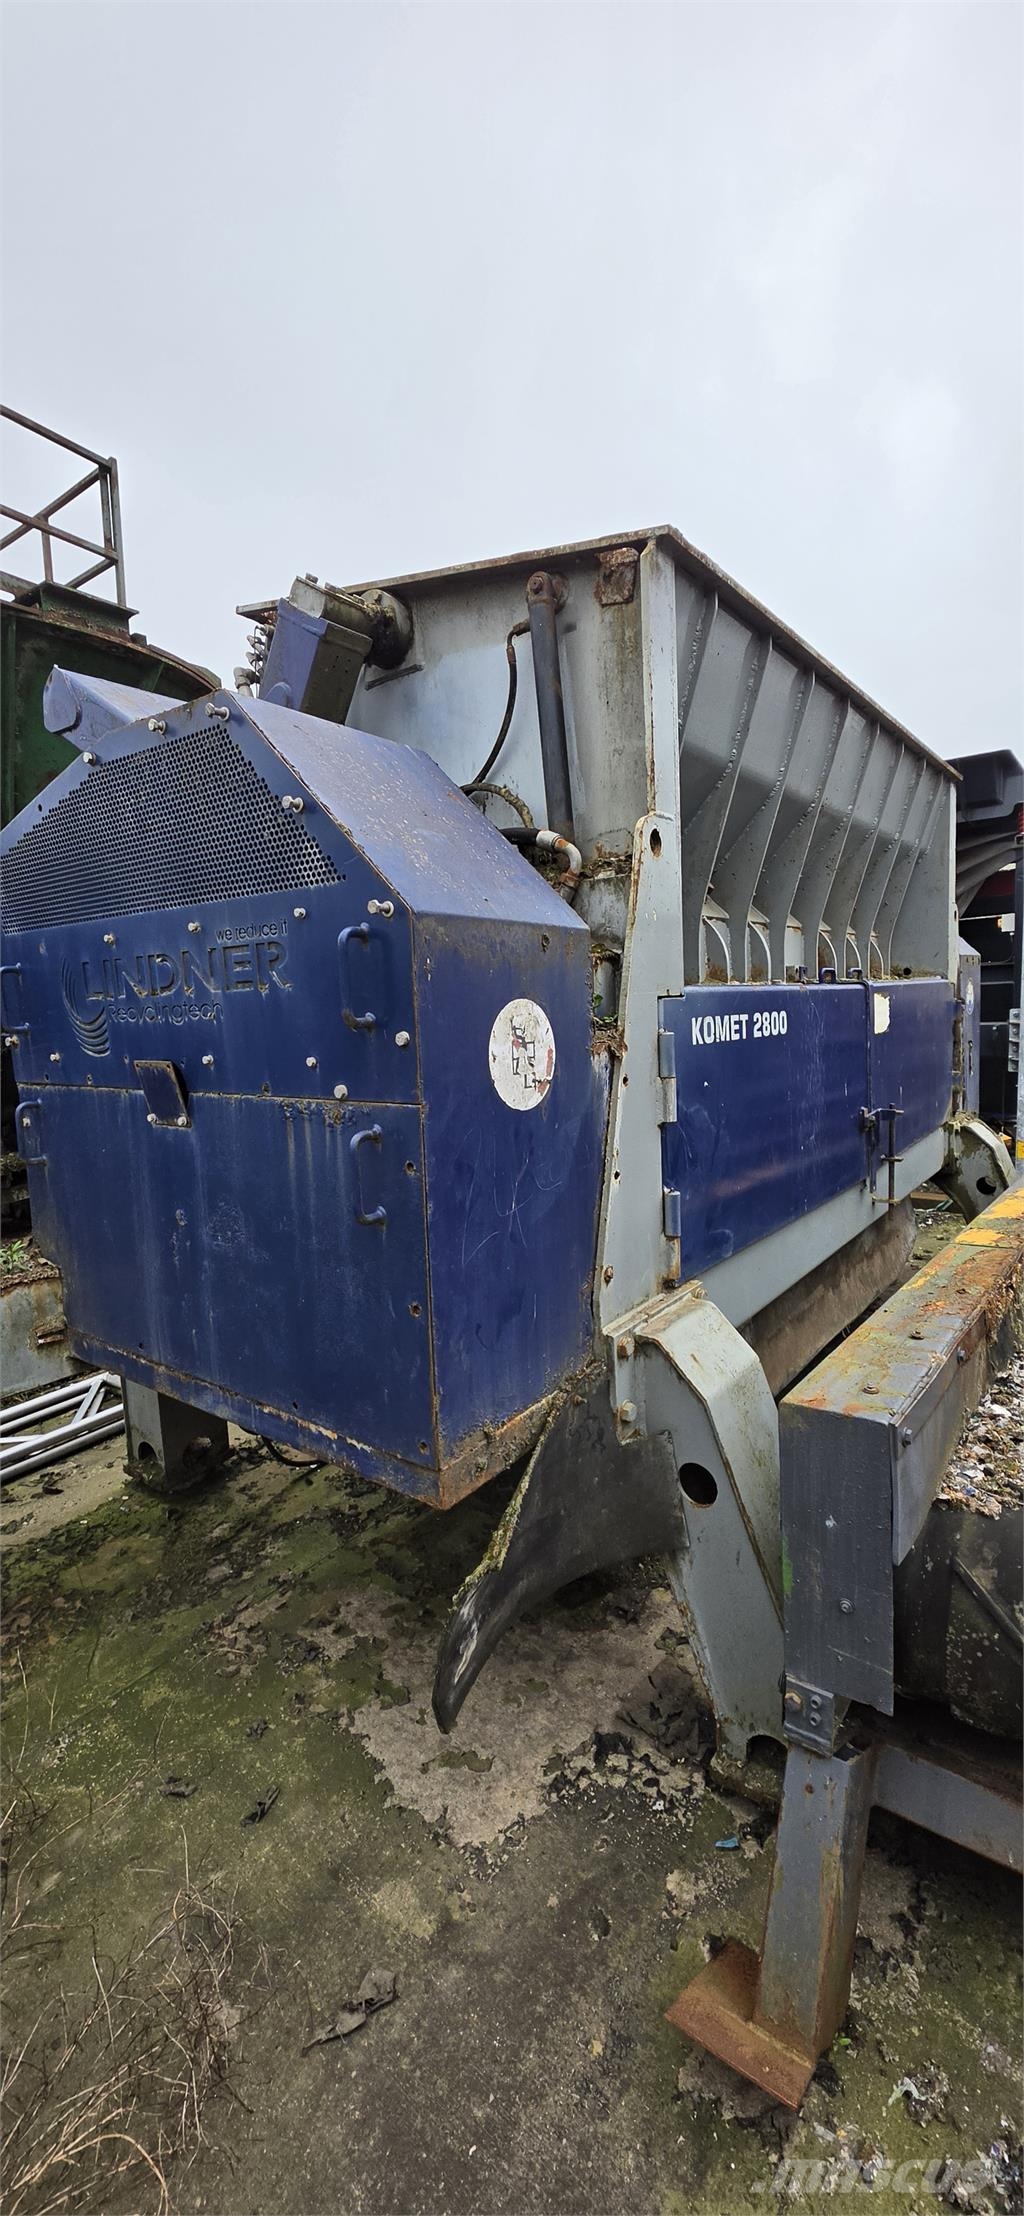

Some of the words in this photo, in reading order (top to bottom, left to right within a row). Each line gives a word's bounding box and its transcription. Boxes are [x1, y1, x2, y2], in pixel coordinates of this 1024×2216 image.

[215, 928, 232, 943] we
[235, 922, 278, 941] reduce
[280, 919, 288, 936] it
[81, 941, 293, 1001] LINDNER
[108, 1001, 224, 1026] Recyclingtech
[691, 1014, 748, 1045] KOMET
[753, 1010, 787, 1038] 2800
